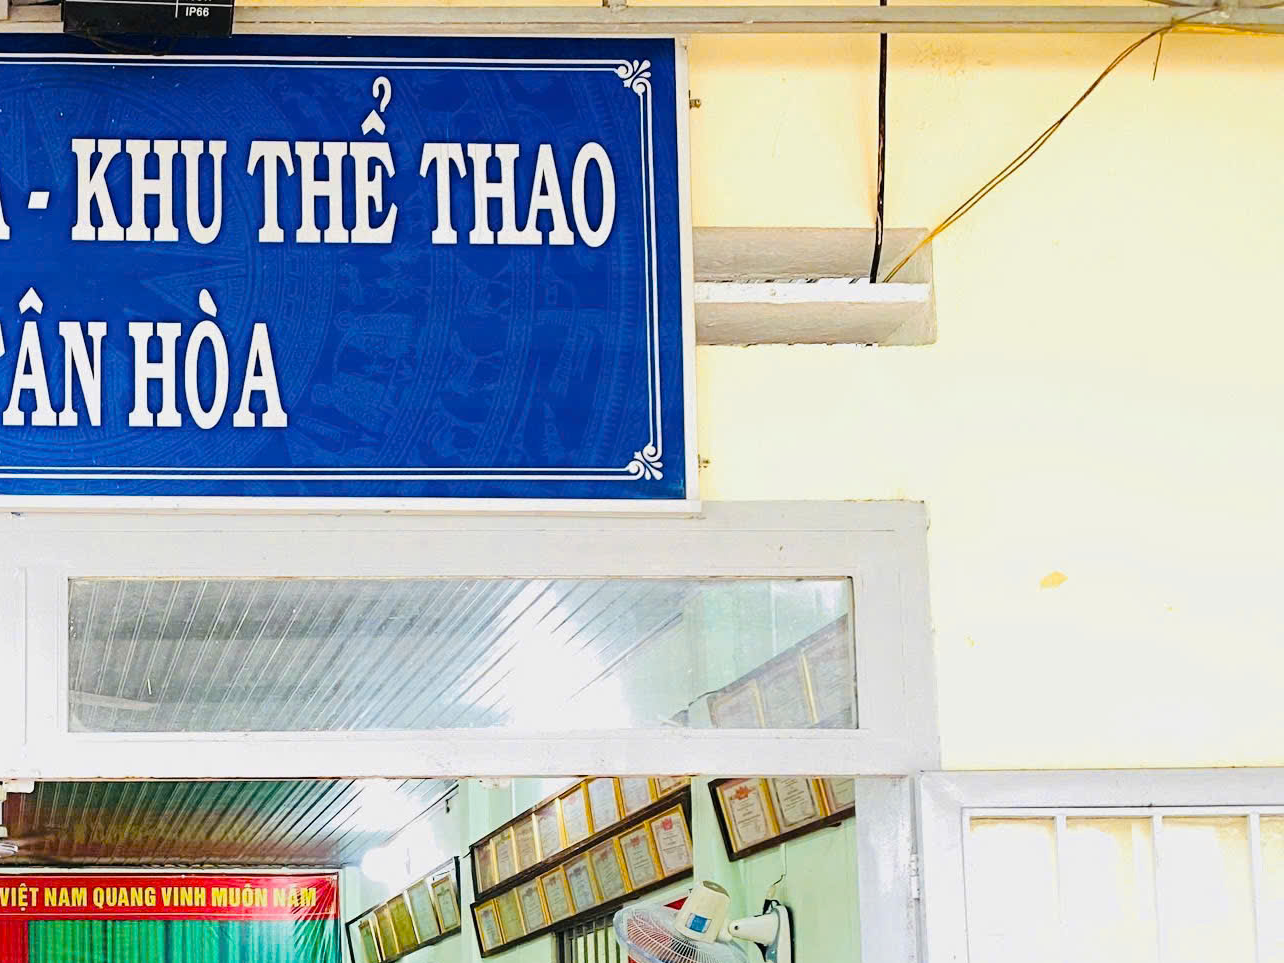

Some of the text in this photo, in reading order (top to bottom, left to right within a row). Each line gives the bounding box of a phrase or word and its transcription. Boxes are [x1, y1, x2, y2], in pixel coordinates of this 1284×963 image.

[186, 6, 209, 17] IP66
[71, 138, 227, 244] KHU
[246, 76, 398, 244] THỂ
[419, 142, 615, 247] THAO
[128, 288, 288, 429] HÒA
[44, 887, 88, 907] NAM
[92, 887, 156, 907] QUANG
[161, 887, 206, 907] VINH
[211, 883, 268, 907] MUÔN
